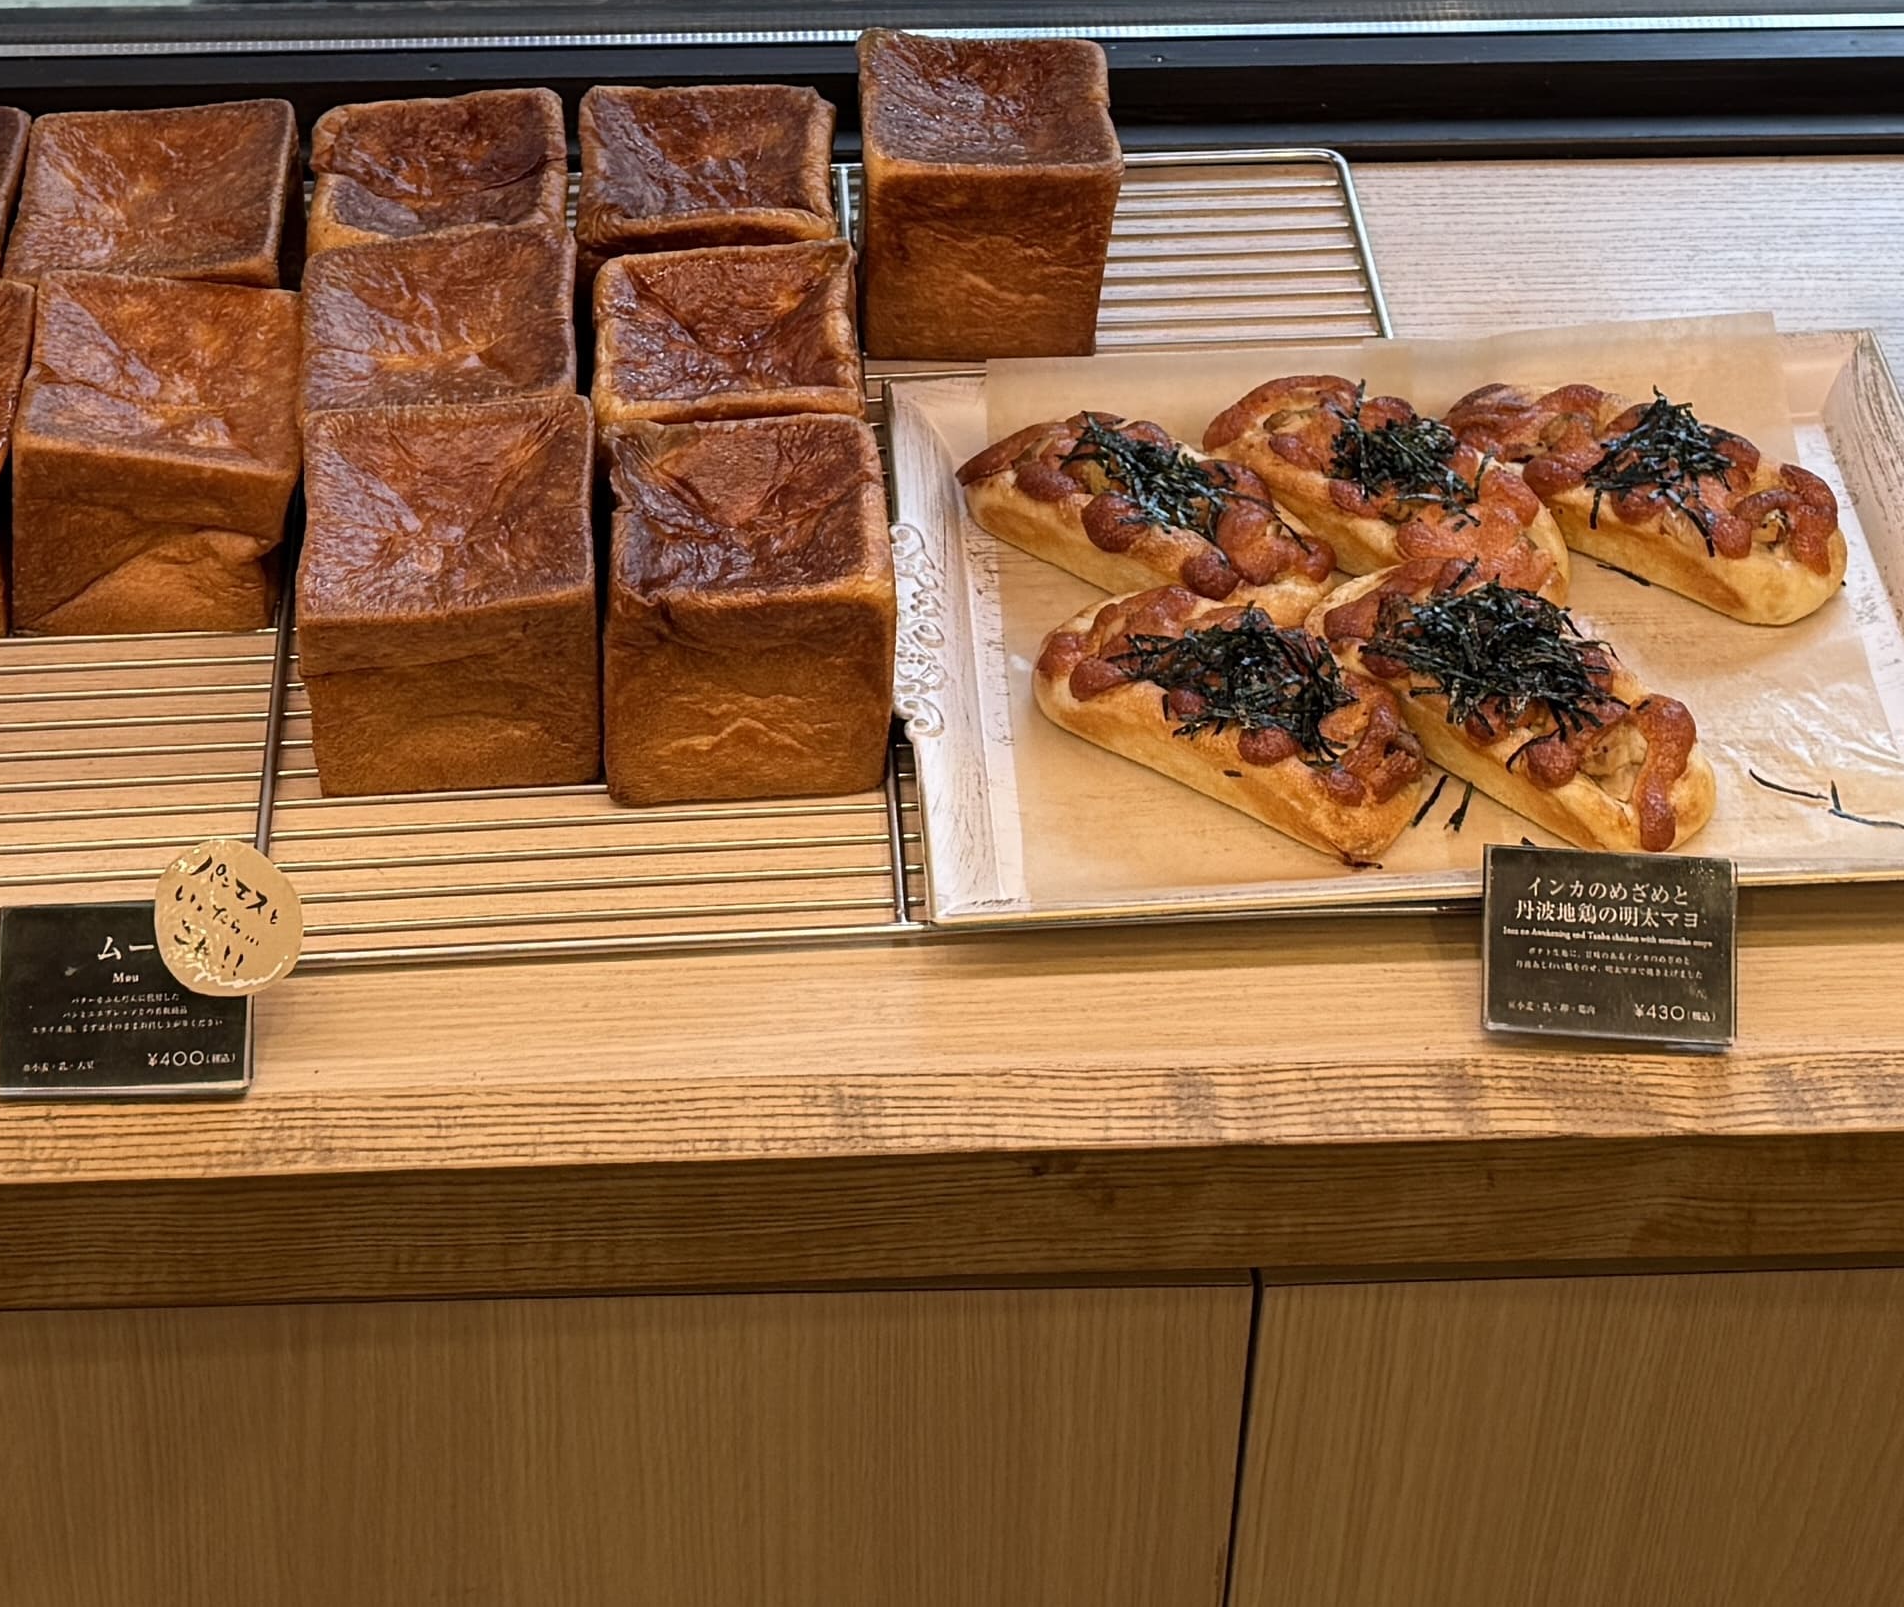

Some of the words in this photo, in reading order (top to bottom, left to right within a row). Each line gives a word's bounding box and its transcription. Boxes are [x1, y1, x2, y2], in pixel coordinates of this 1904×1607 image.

[1527, 876, 1690, 906] インカのめざめと
[1514, 898, 1700, 929] 丹波地鶏の明太マヨ
[97, 935, 155, 961] ムー
[112, 971, 140, 984] Mou
